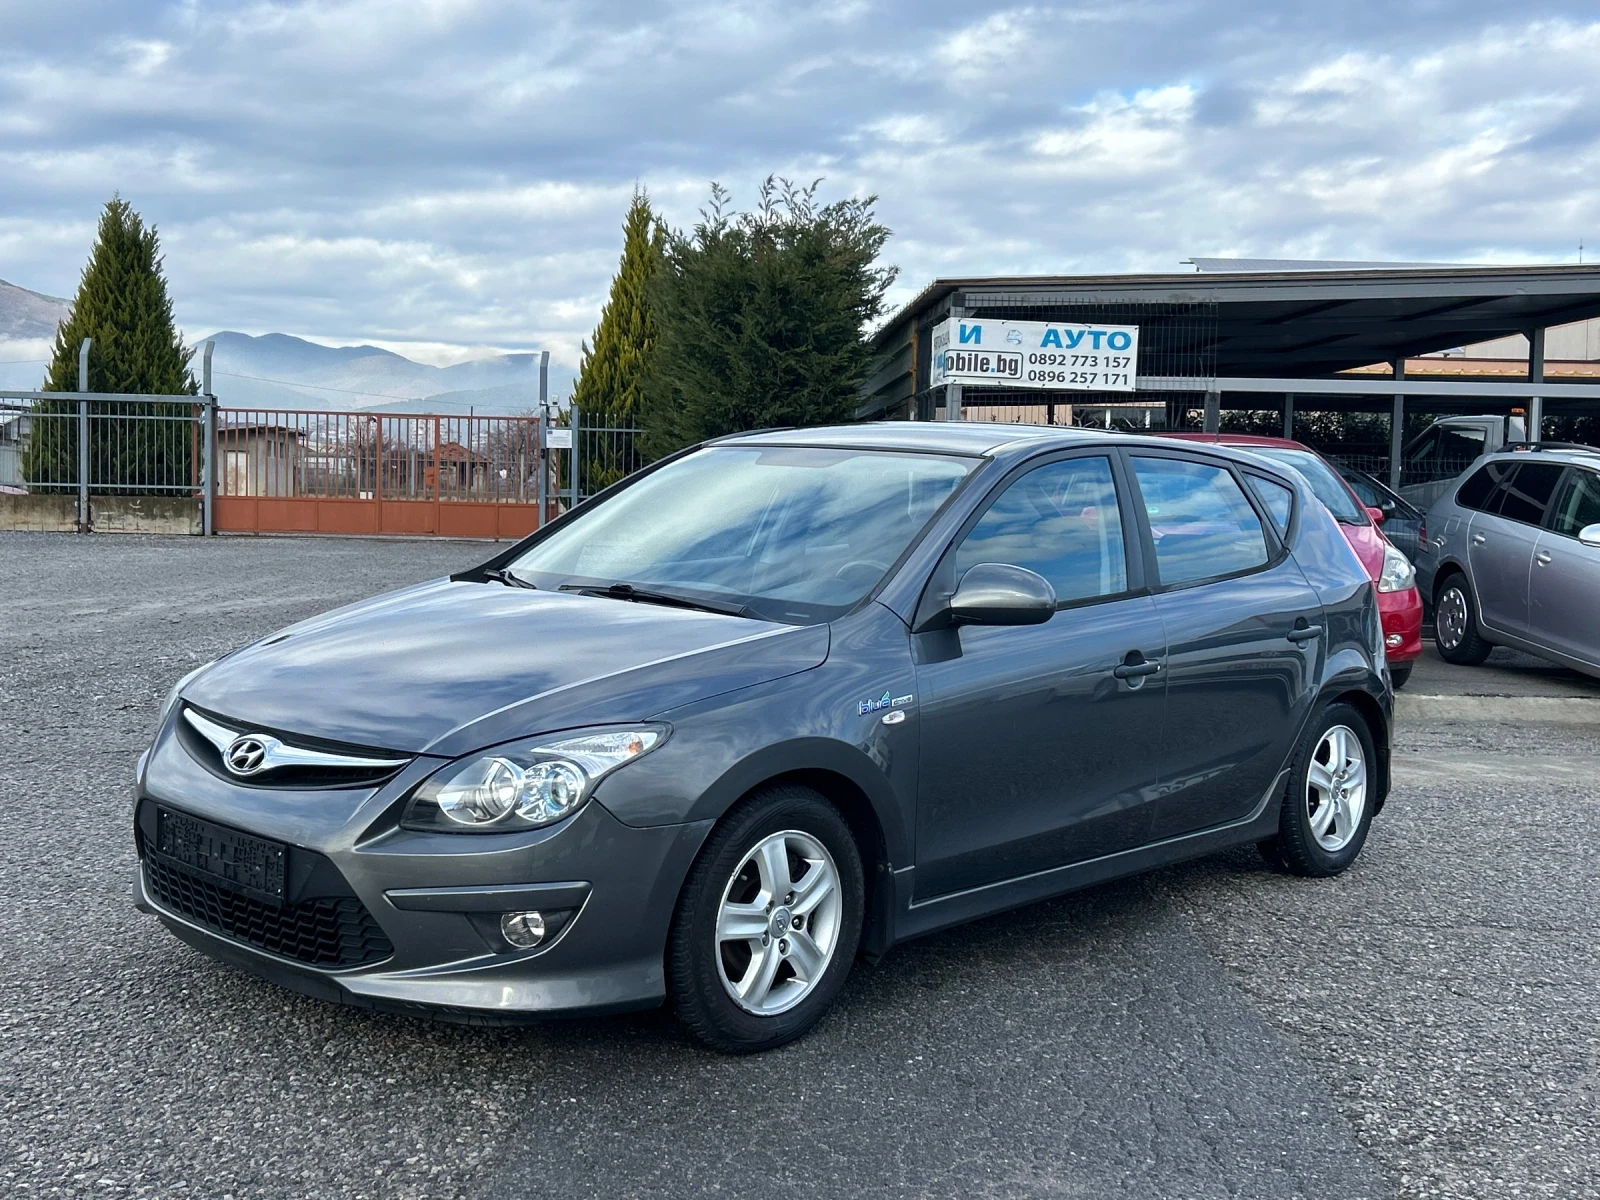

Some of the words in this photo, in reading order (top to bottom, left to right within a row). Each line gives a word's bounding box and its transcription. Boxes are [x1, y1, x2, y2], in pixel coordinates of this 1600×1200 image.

[959, 324, 982, 344] И
[1040, 328, 1132, 351] АУТО
[945, 353, 1019, 376] obile.bg
[1028, 352, 1066, 366] 0892
[1071, 354, 1098, 367] 773
[1103, 356, 1131, 369] 157
[1027, 369, 1066, 383] 0896
[1069, 371, 1098, 384] 257
[1102, 373, 1128, 386] 171
[857, 693, 891, 716] blue
